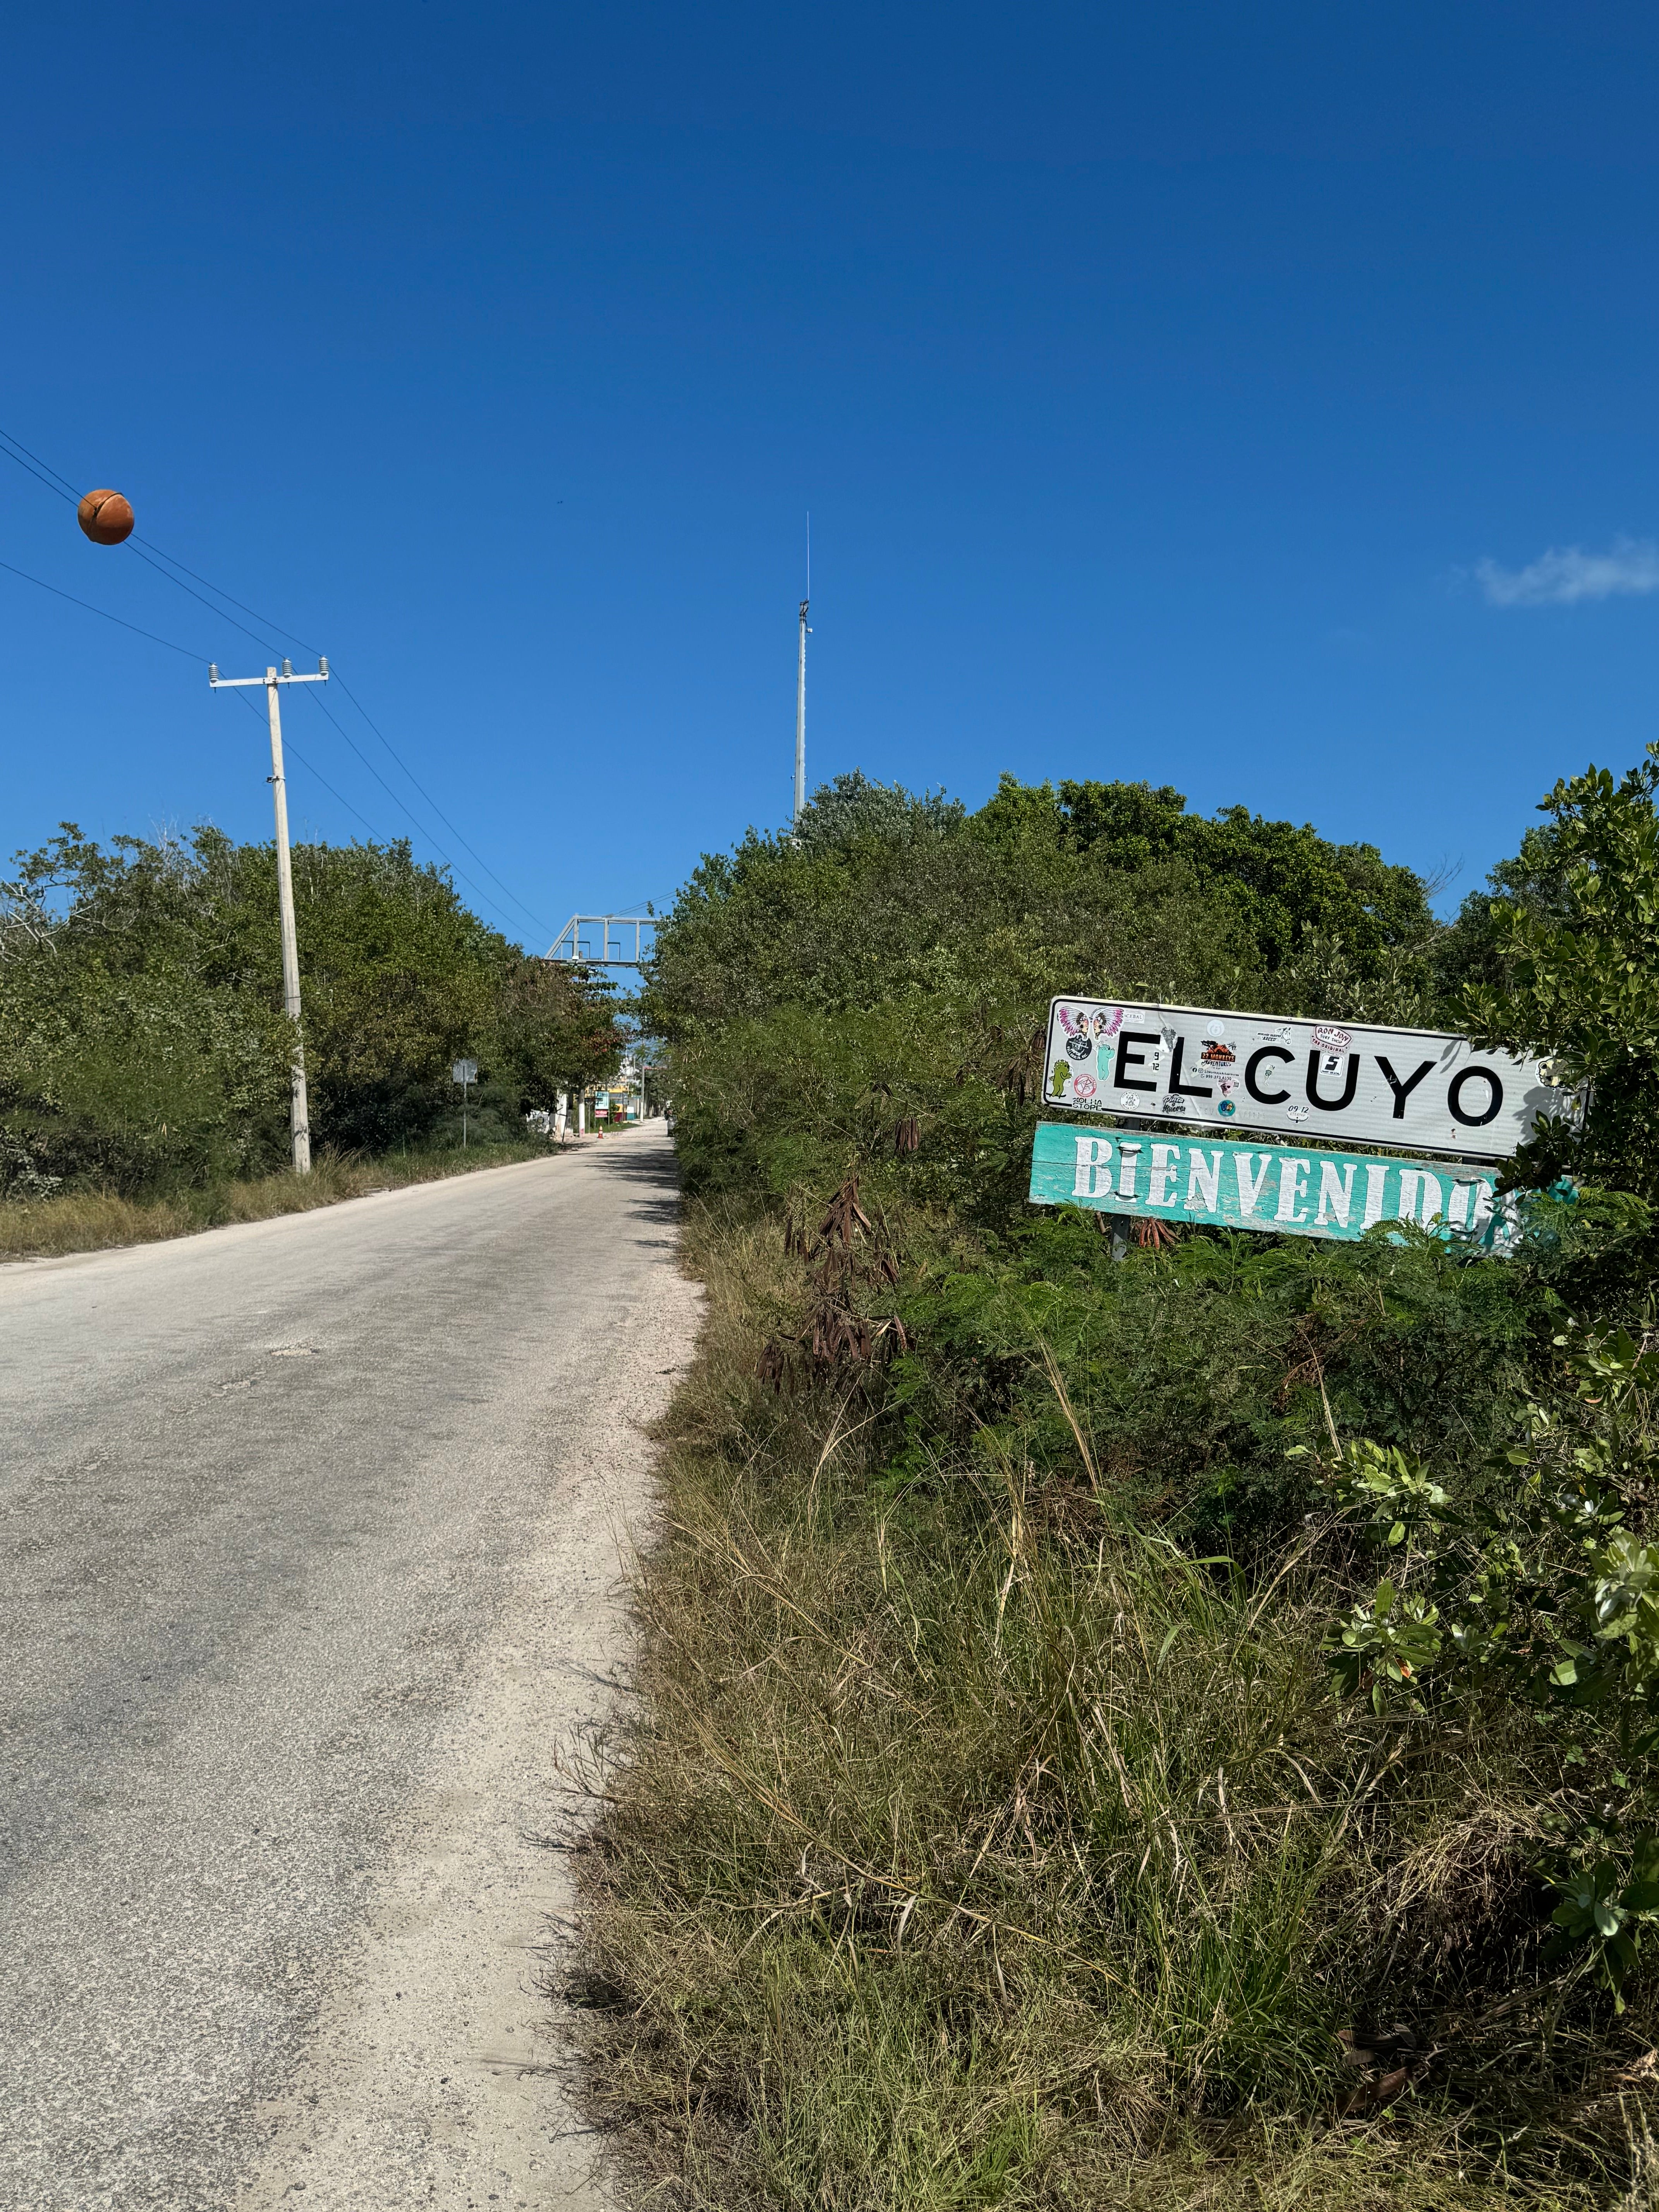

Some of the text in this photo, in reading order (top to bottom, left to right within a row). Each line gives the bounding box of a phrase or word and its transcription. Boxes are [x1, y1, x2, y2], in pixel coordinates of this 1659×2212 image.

[1334, 1032, 1349, 1042] JON
[1322, 1044, 1345, 1053] ORIGINAL
[1154, 1052, 1159, 1060] 9
[1114, 1031, 1503, 1127] EL CUYO
